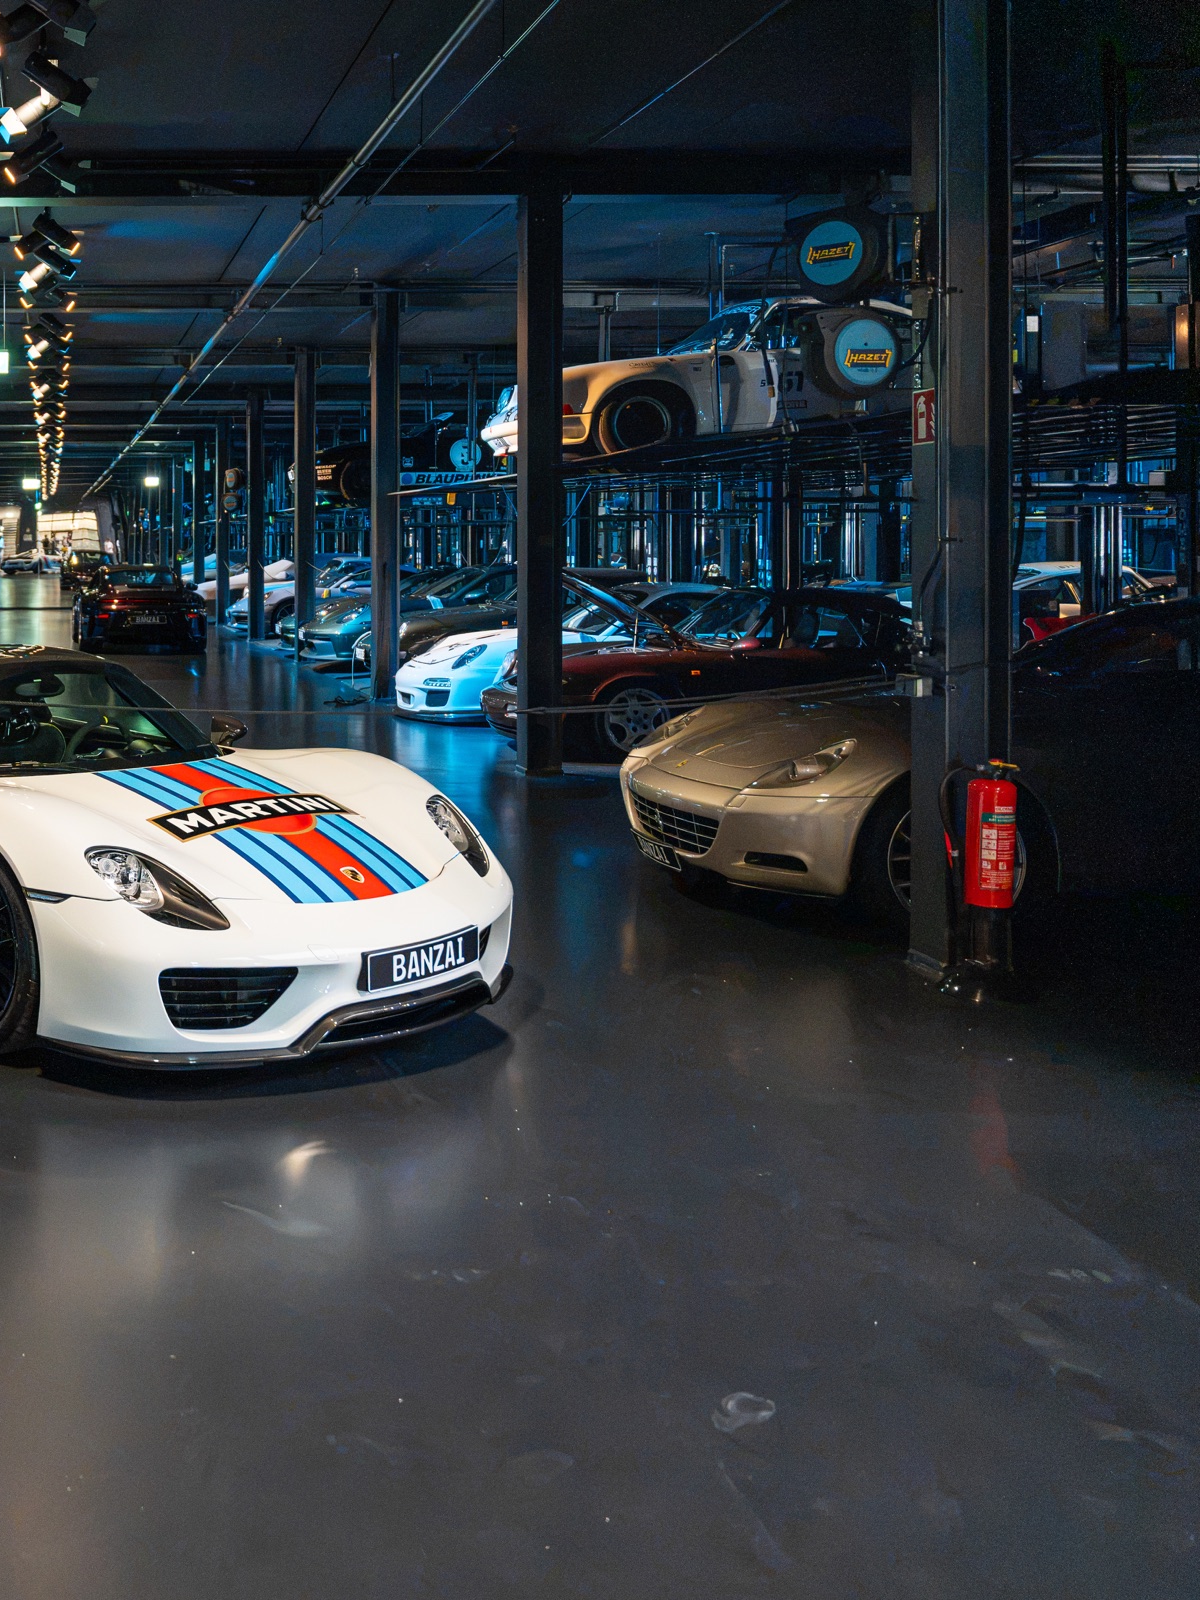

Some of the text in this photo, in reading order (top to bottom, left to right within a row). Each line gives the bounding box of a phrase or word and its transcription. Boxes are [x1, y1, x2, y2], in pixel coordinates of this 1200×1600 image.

[810, 244, 852, 262] HAZET
[847, 351, 890, 365] HAZET
[166, 795, 341, 834] MARTINI
[392, 936, 465, 982] BANZAI
